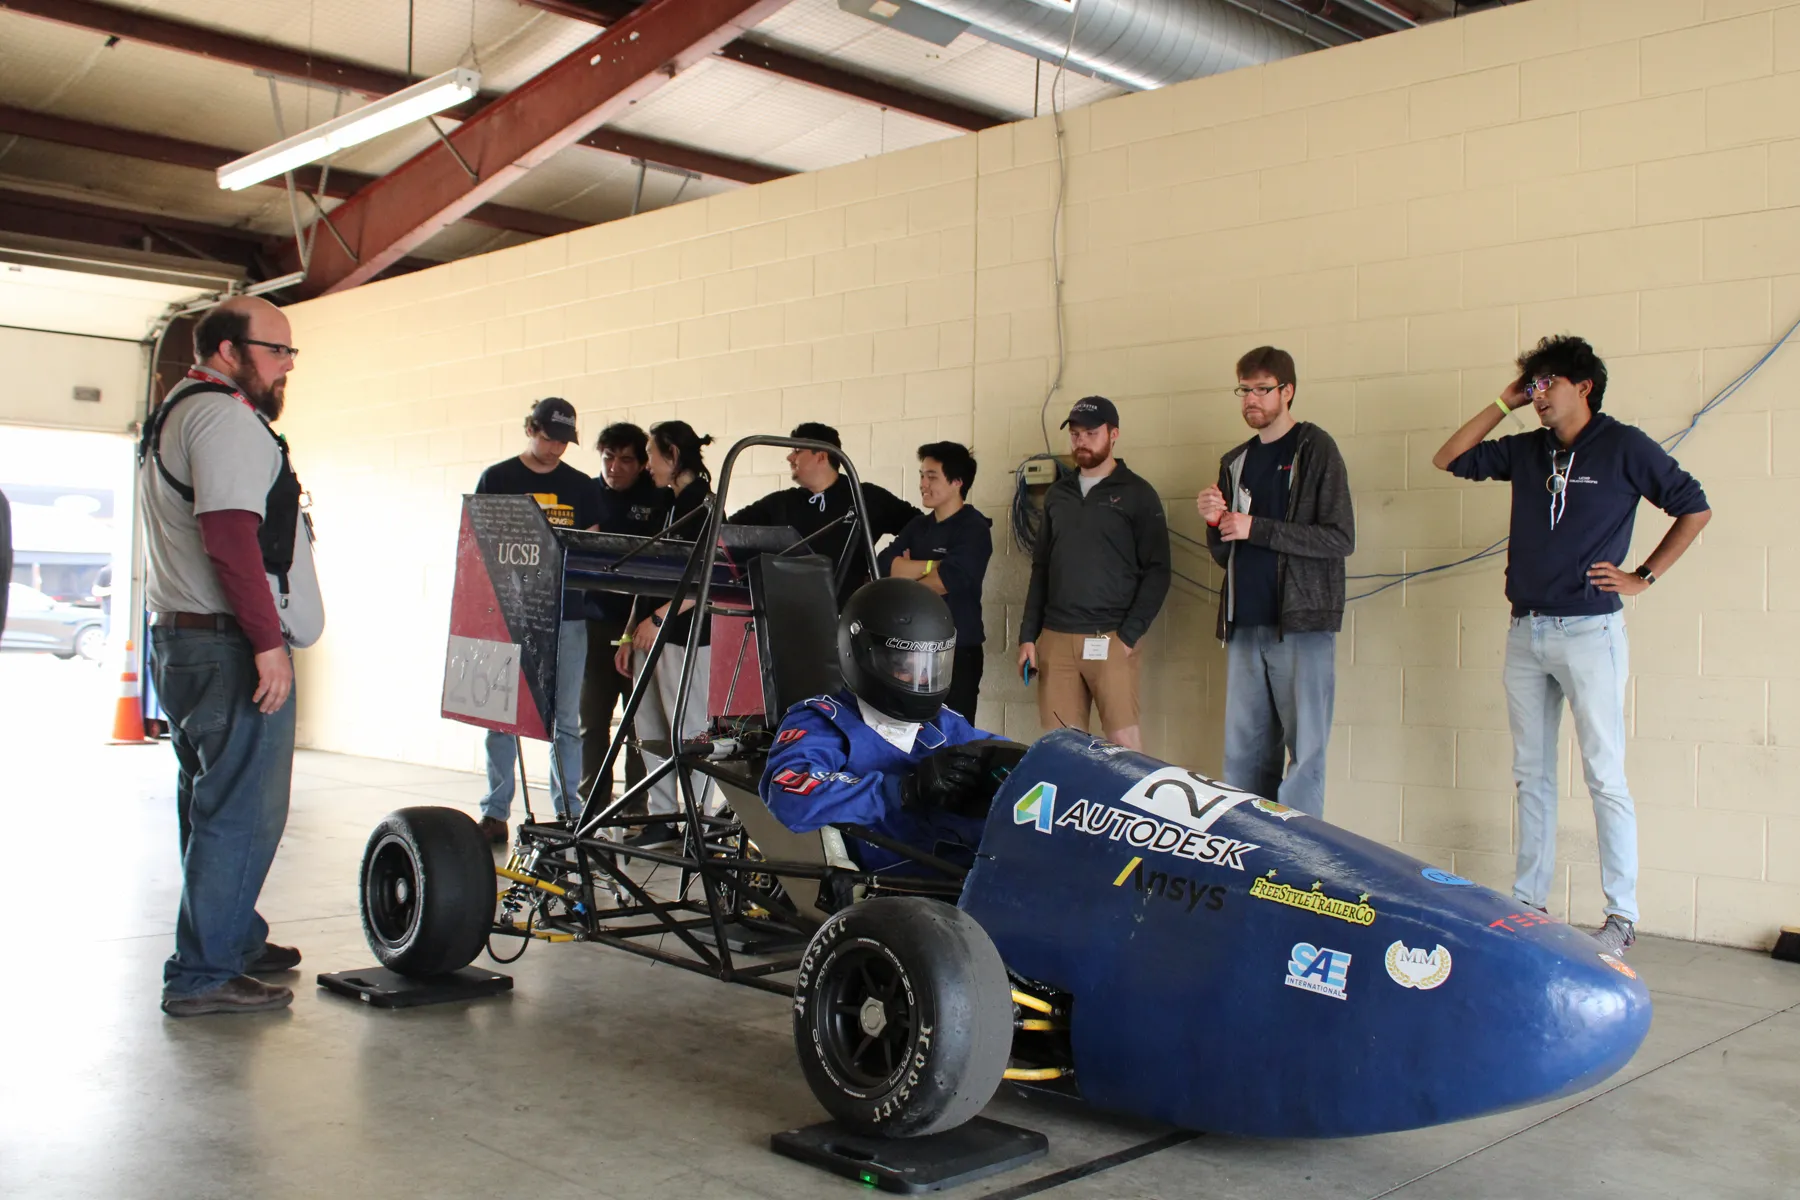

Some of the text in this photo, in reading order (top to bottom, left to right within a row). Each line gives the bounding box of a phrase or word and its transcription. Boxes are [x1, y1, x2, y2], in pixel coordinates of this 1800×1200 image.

[498, 542, 541, 566] UCSB
[1056, 799, 1260, 870] AUTODESK
[1113, 857, 1227, 913] Ansys
[1288, 942, 1352, 990] SAE
[1400, 948, 1437, 966] MM
[1286, 976, 1342, 998] INTERNATIONAL
[873, 1018, 934, 1123] Hoosier
